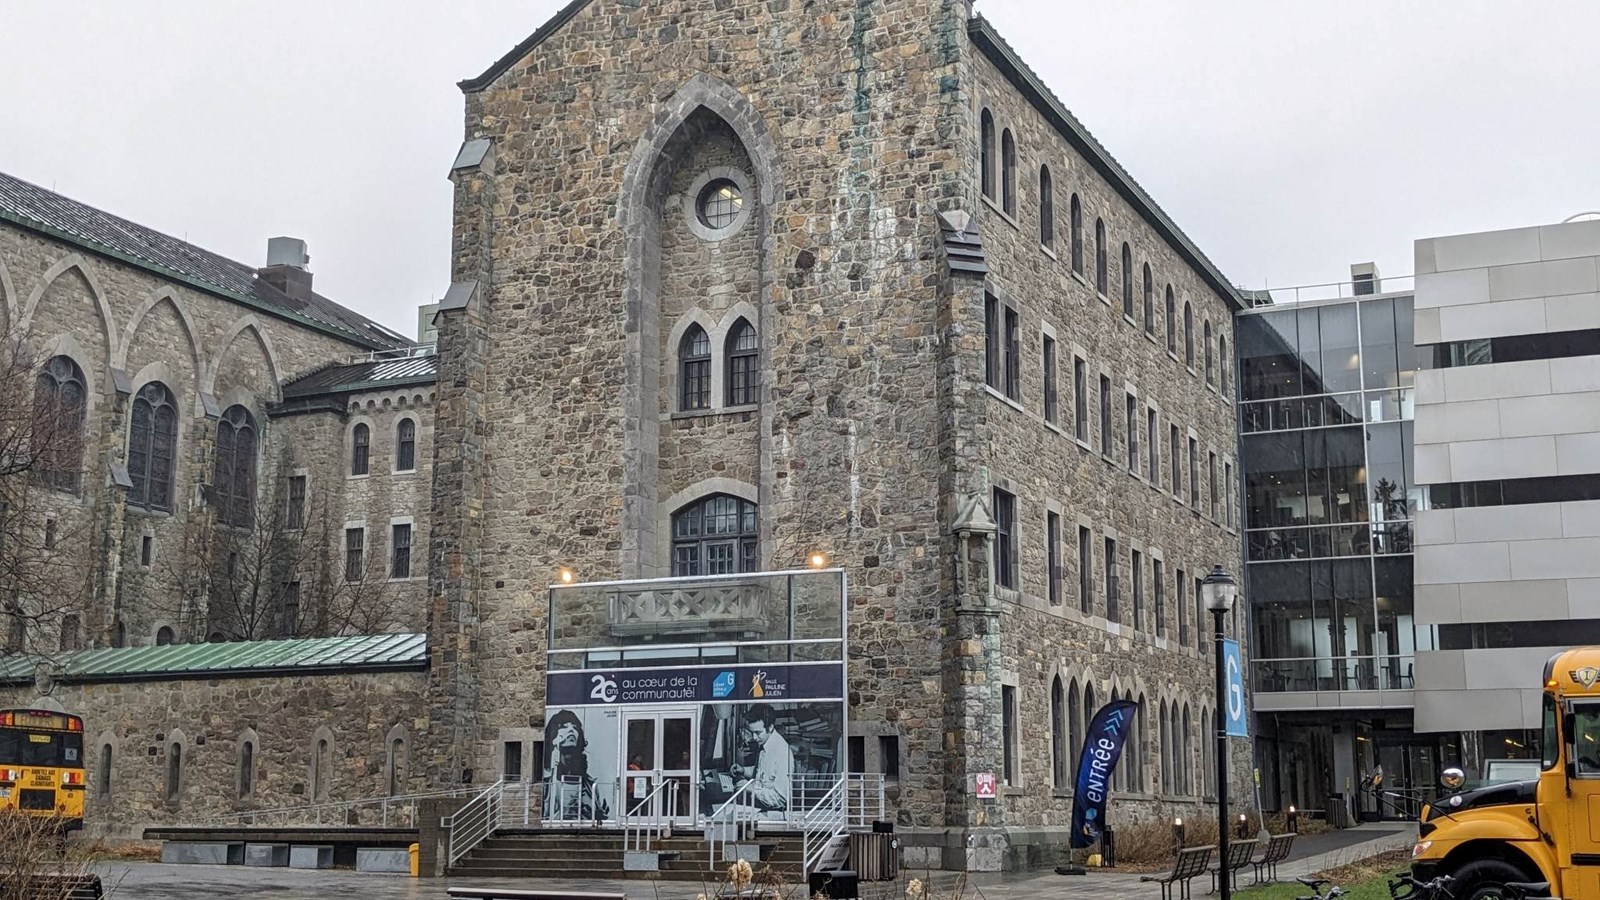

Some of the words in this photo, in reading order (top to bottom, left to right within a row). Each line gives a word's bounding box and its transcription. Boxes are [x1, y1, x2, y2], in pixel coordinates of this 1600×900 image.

[622, 679, 636, 688] au
[669, 675, 685, 687] de
[687, 675, 698, 686] la
[727, 673, 735, 686] G
[621, 687, 695, 700] communauté!
[1227, 654, 1241, 721] G
